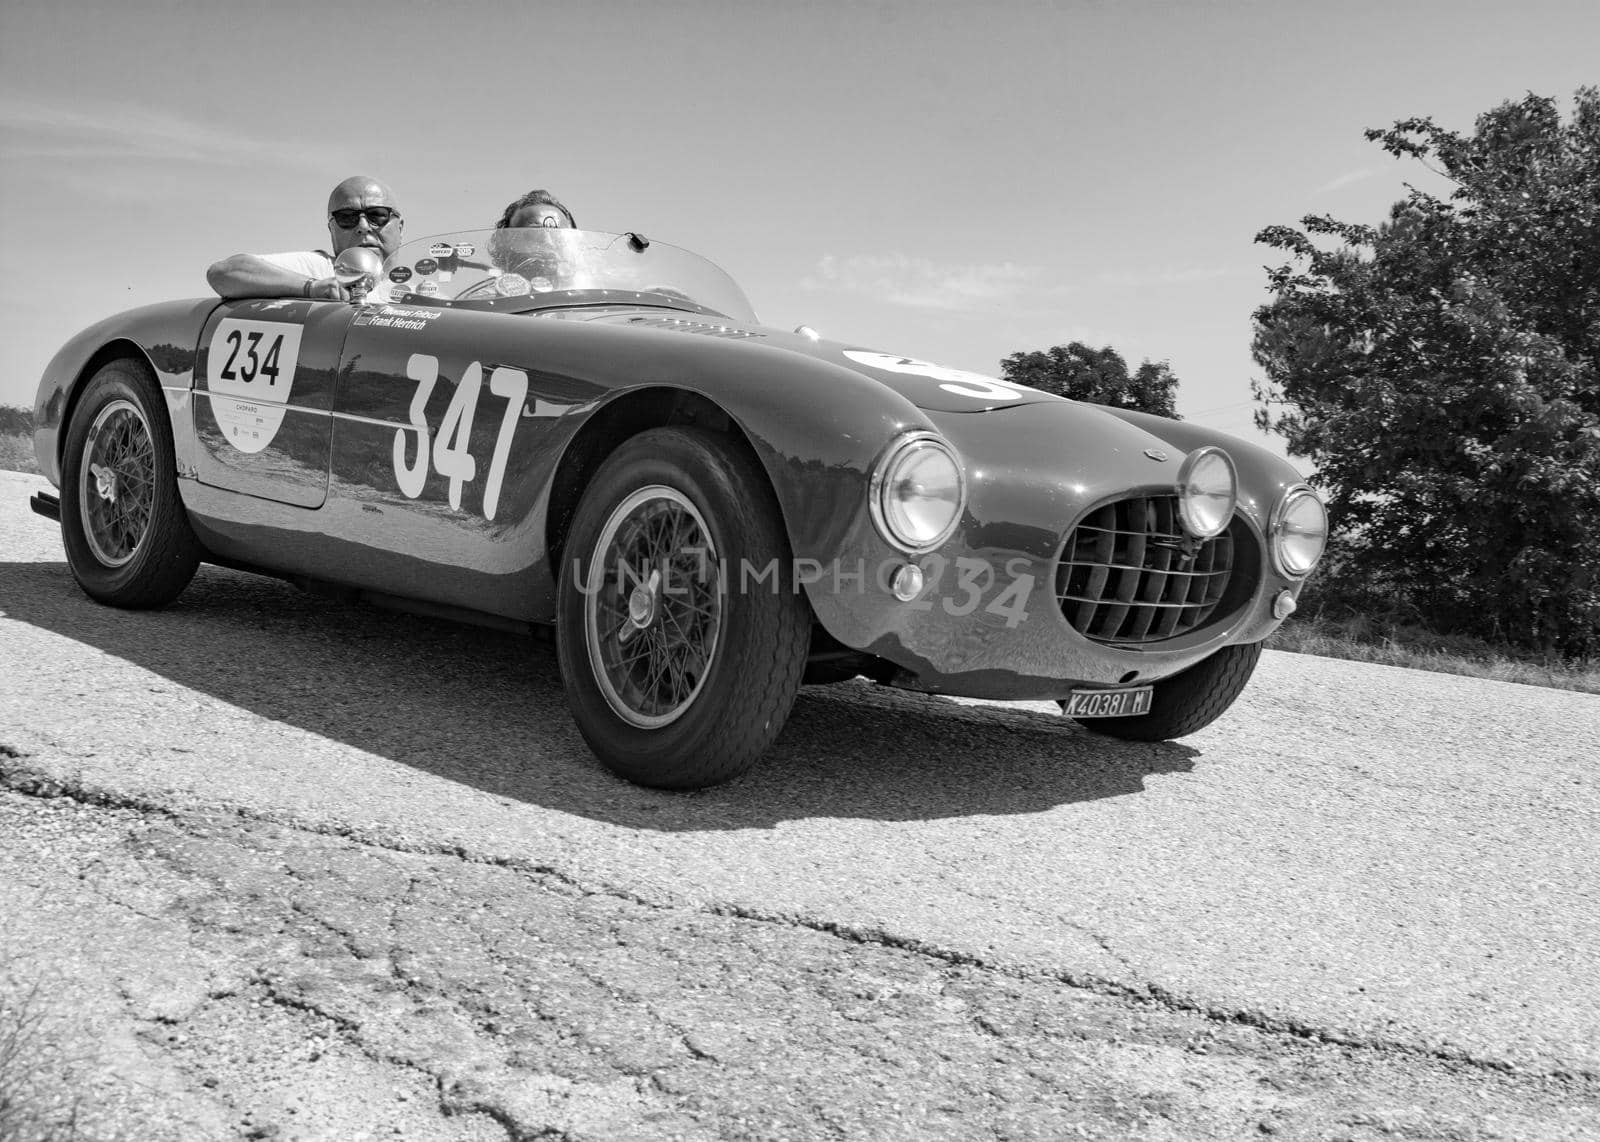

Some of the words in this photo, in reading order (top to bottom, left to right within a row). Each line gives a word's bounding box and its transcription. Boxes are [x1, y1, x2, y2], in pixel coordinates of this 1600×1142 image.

[368, 316, 395, 327] Frank
[220, 329, 285, 386] 234
[393, 353, 528, 521] 347
[905, 553, 1035, 629] 234
[1064, 693, 1129, 715] K40381
